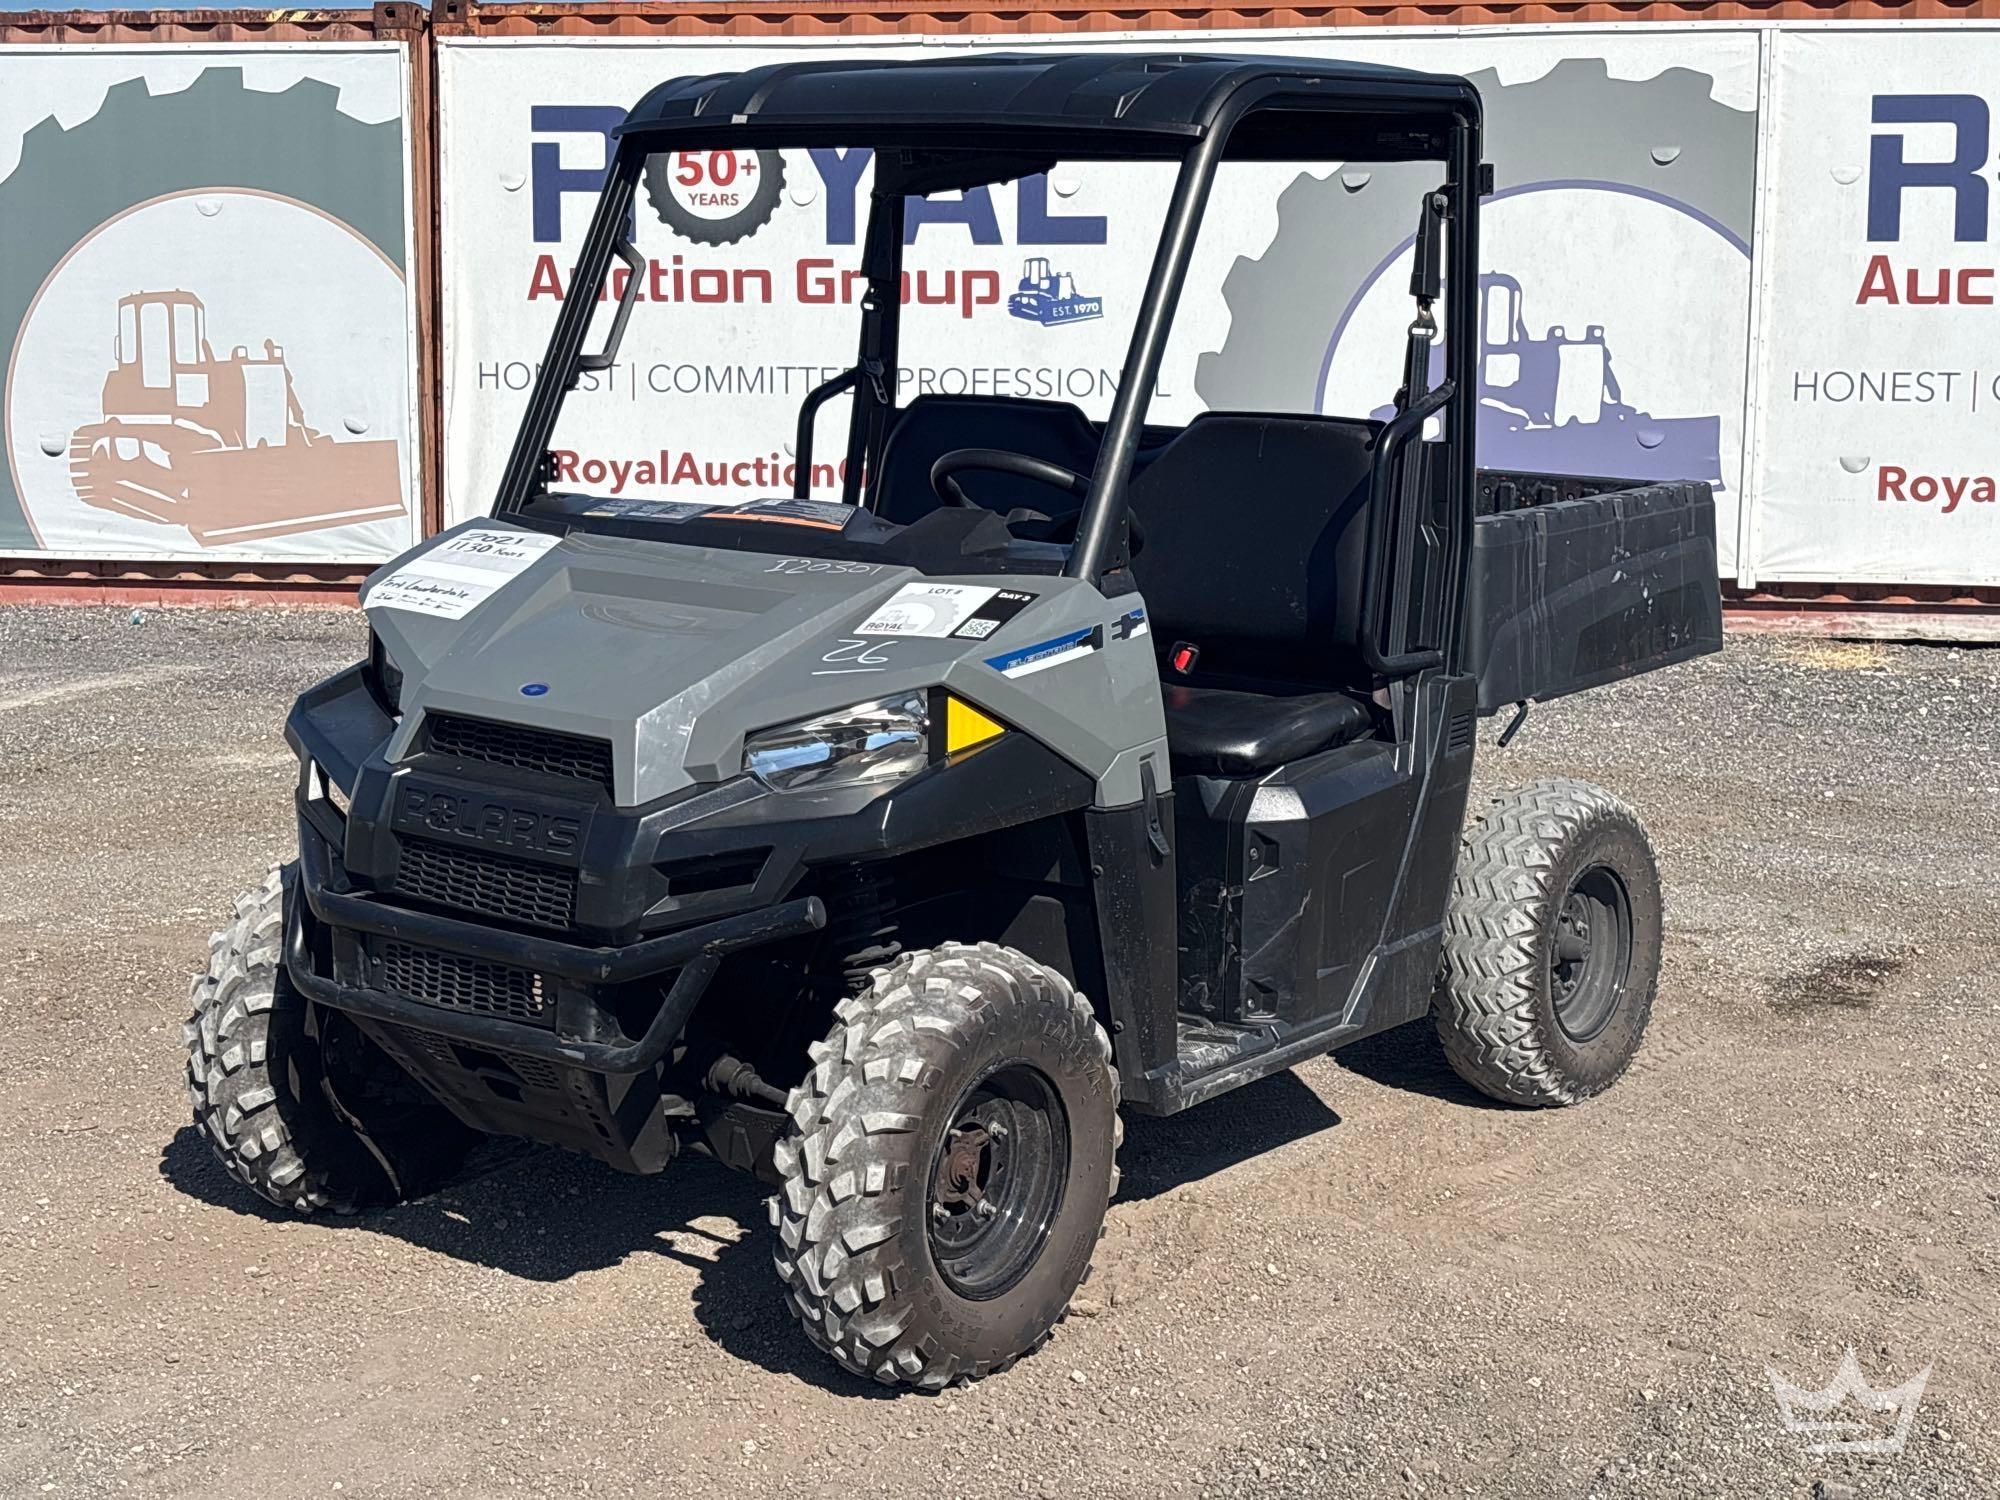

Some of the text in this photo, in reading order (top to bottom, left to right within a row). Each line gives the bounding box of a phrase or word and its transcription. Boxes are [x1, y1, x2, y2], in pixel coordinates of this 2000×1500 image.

[676, 150, 757, 187] 50+
[688, 193, 739, 206] YEARS
[1856, 255, 1995, 305] Auc
[1052, 302, 1100, 317] EST. 1970
[479, 362, 1172, 398] HOST COMMITTE PROFESSIONL
[1794, 371, 1962, 402] HONEST
[1877, 466, 1996, 513] Roya
[460, 533, 525, 545] 2021
[447, 541, 493, 553] 1130
[928, 587, 952, 595] LOT
[997, 592, 1022, 600] DAY
[864, 622, 904, 631] ROYAL
[400, 786, 581, 857] POLARIS
